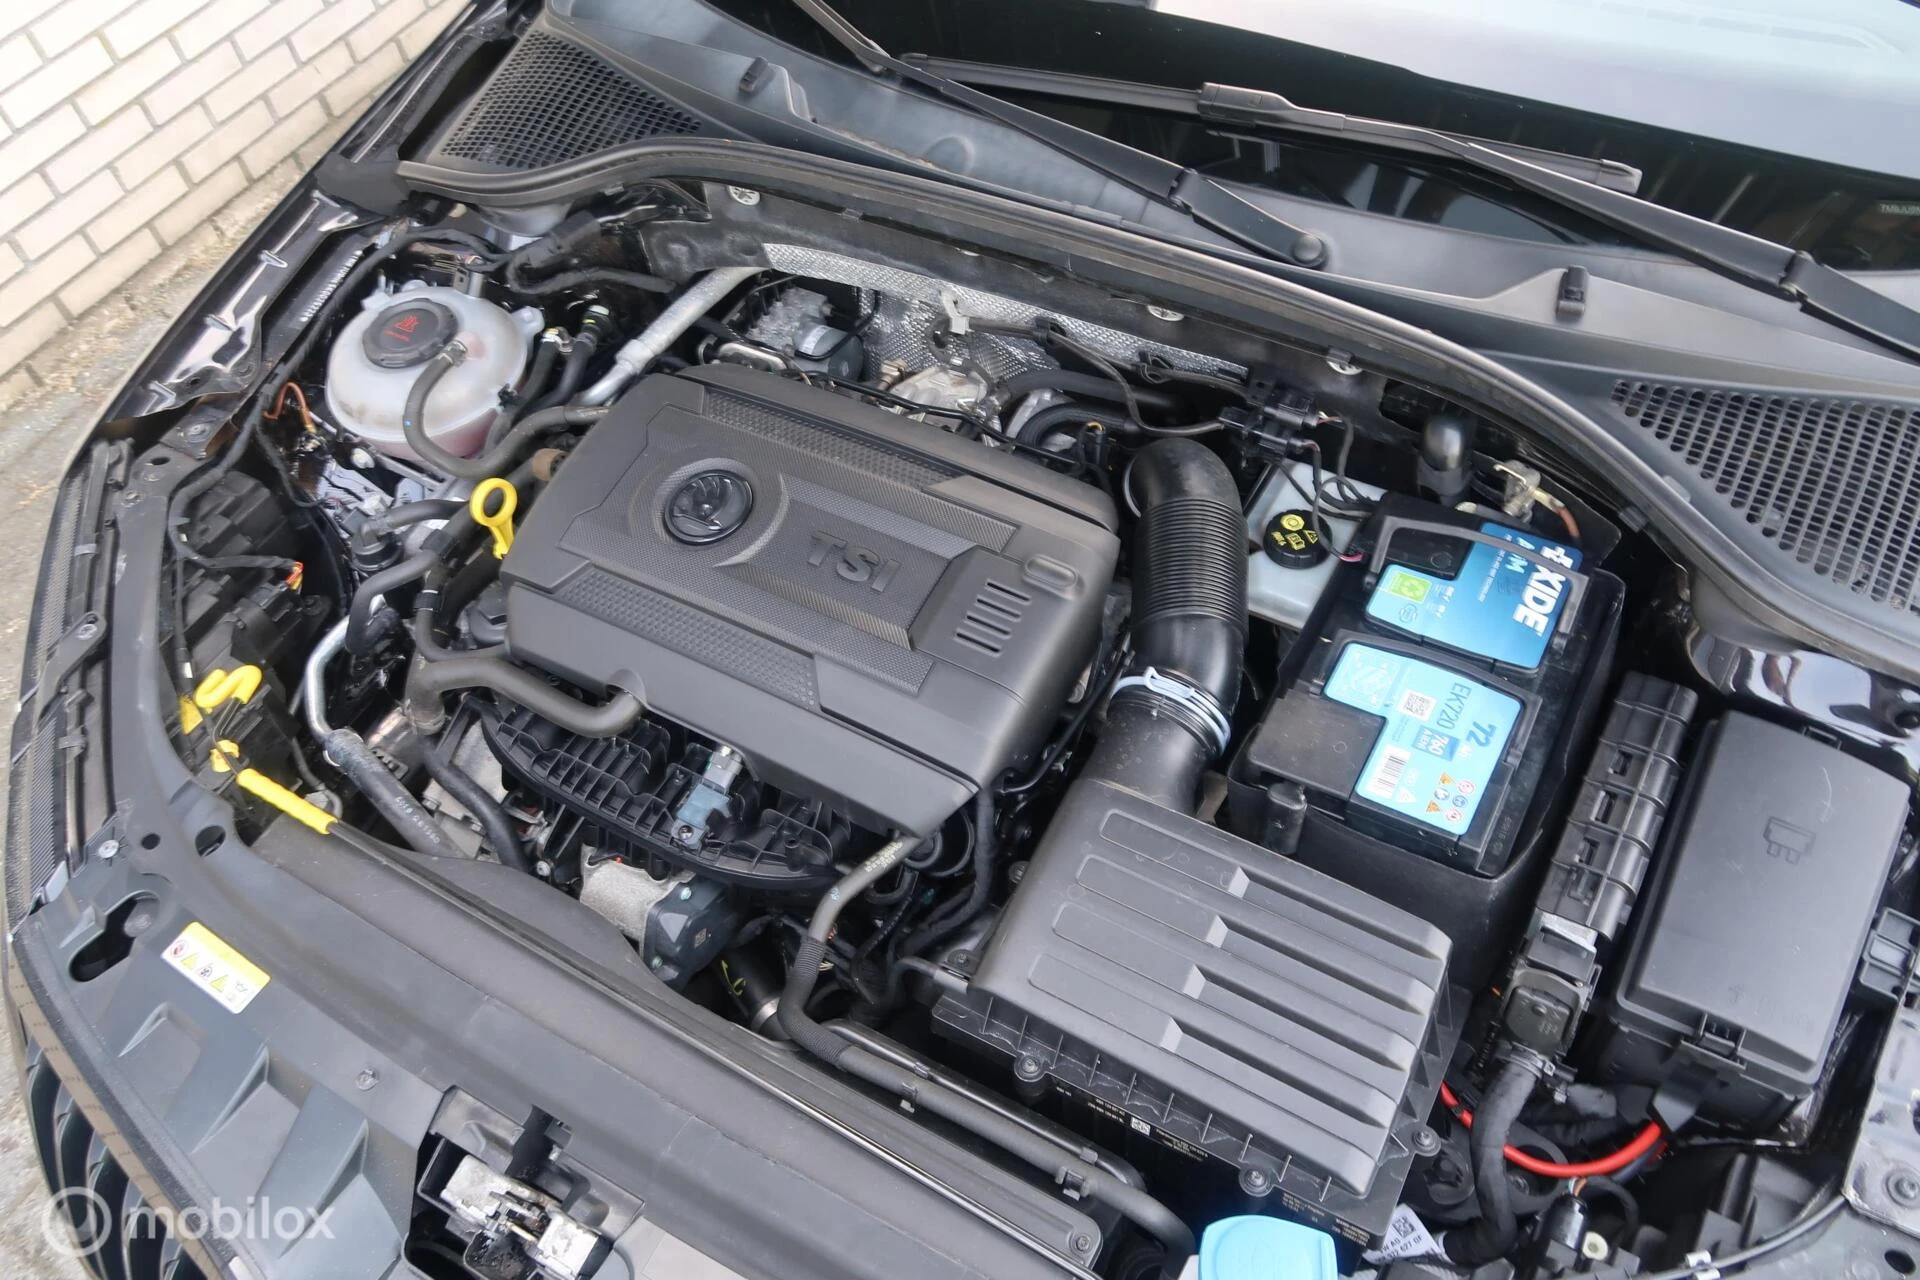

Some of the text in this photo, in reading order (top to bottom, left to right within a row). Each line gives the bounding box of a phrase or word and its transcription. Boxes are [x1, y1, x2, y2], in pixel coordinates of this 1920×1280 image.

[807, 530, 900, 593] TSI
[1505, 537, 1535, 573] AM
[1437, 682, 1472, 730] EK720
[1429, 735, 1449, 756] 760
[1466, 721, 1497, 747] 72
